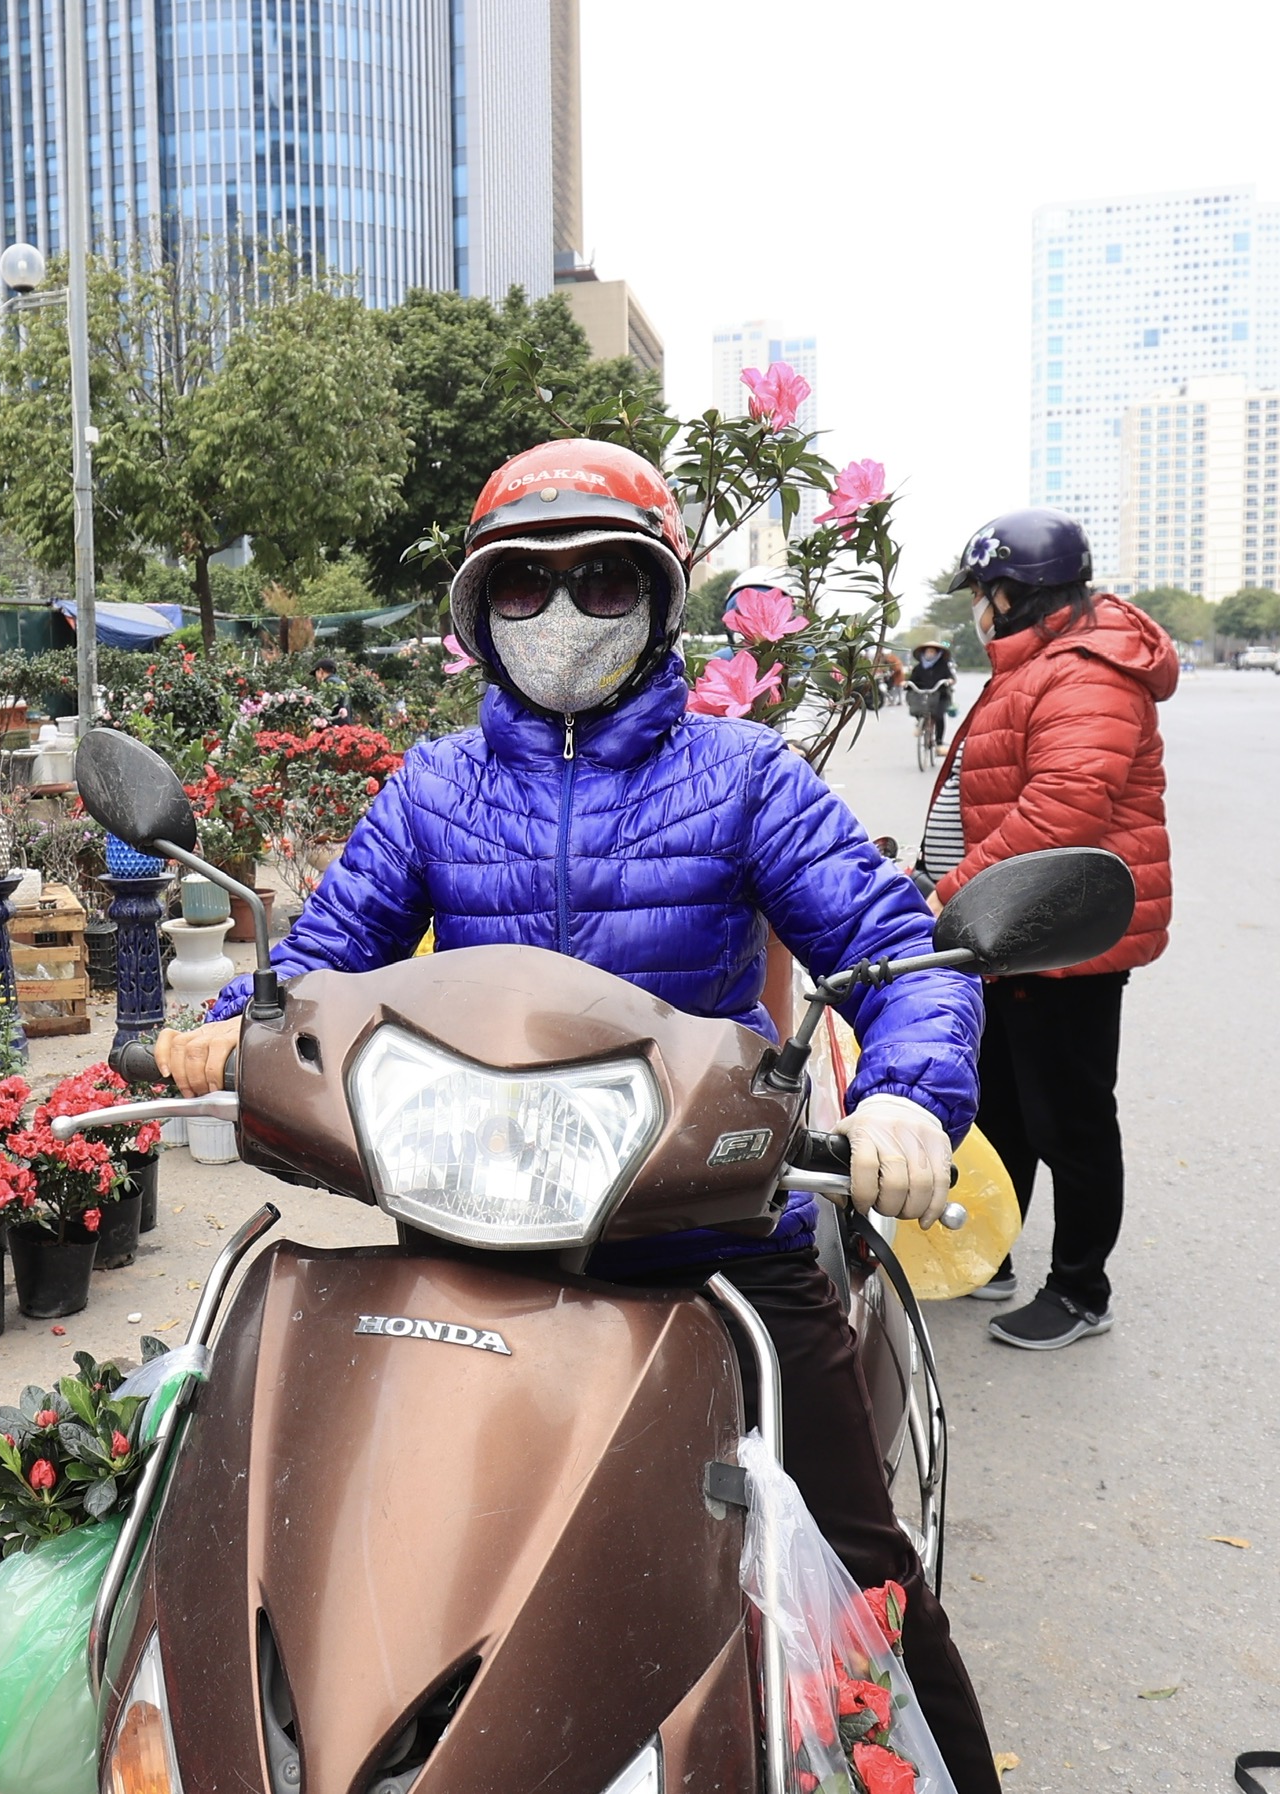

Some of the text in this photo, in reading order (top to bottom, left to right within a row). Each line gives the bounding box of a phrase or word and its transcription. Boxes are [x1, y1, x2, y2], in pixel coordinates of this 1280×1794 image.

[507, 468, 606, 492] OSAKAR
[716, 1133, 766, 1157] FI
[354, 1315, 513, 1356] HONDA
